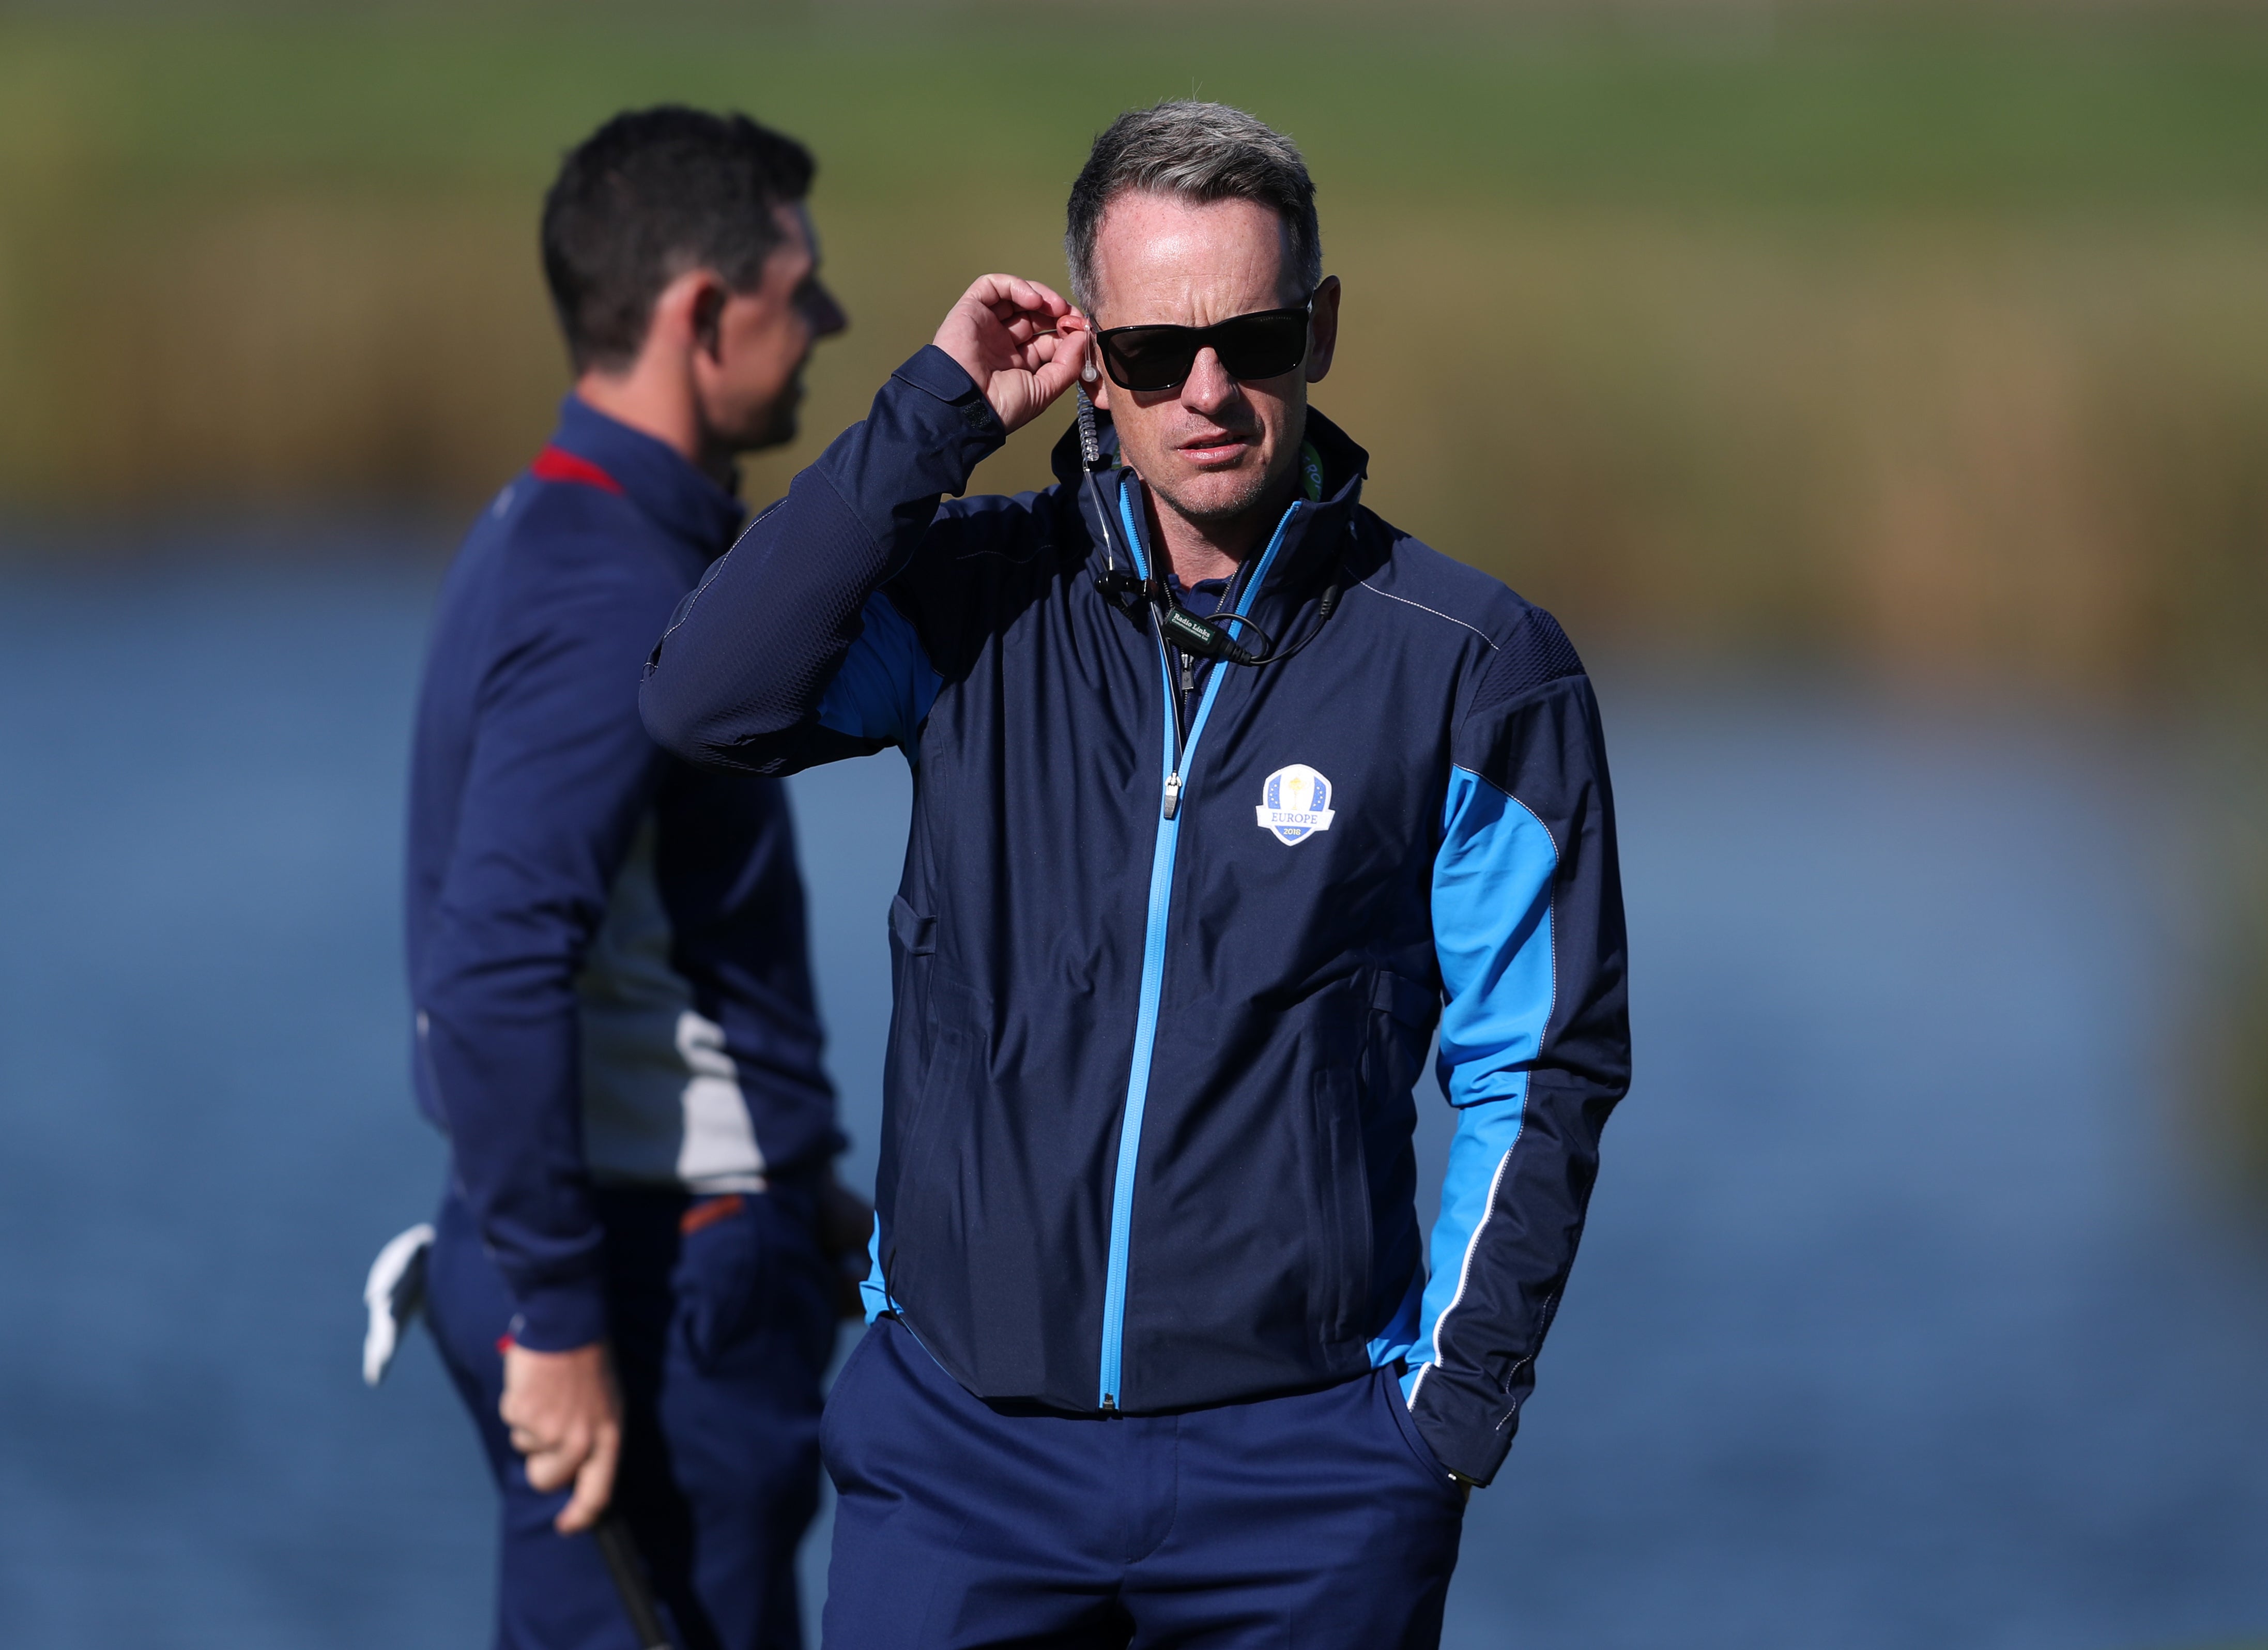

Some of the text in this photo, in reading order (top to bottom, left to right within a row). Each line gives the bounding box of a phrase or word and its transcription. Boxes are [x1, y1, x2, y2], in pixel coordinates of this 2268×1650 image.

[1174, 613, 1210, 637] Radio Links
[1272, 813, 1317, 824] EUROPE
